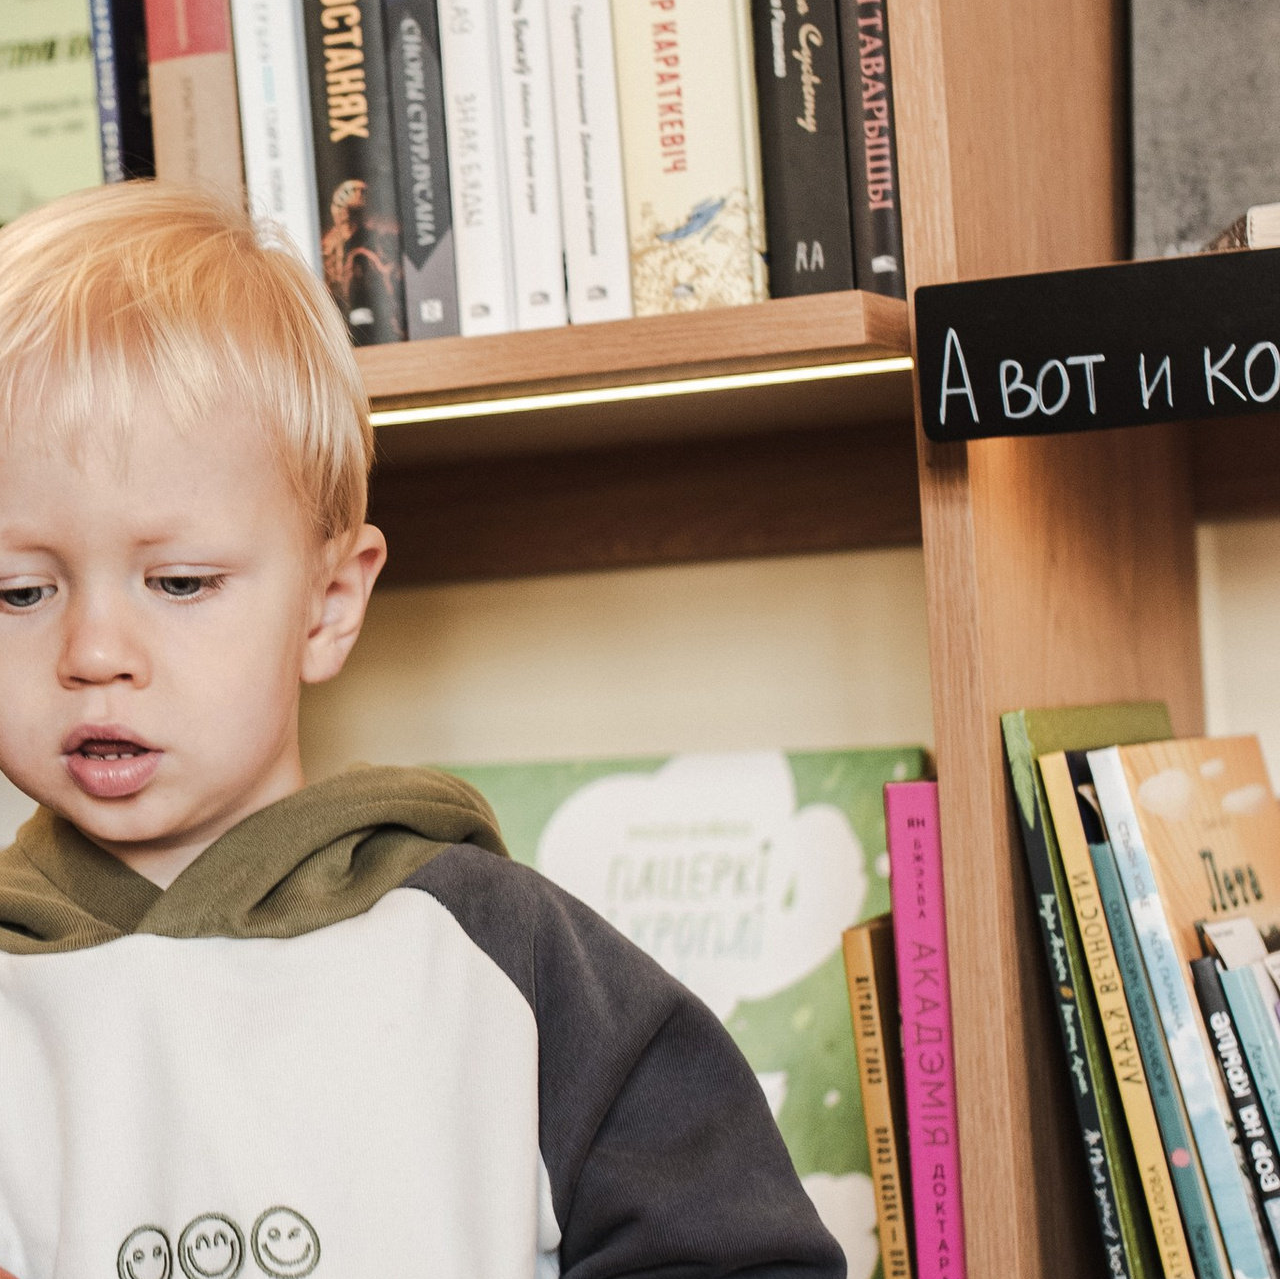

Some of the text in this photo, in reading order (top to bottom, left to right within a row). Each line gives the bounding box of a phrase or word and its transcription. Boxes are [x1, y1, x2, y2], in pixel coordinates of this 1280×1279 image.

[651, 20, 688, 175] КАРАТКЕВІЧ
[857, 9, 894, 211] ТАВАРЫШЫ
[939, 326, 980, 425] А
[1072, 868, 1119, 995] ВЕЧНОСТИ
[911, 940, 951, 1147] АКАДЭМІЯ
[1103, 1006, 1144, 1085] ЛАДЬЯ
